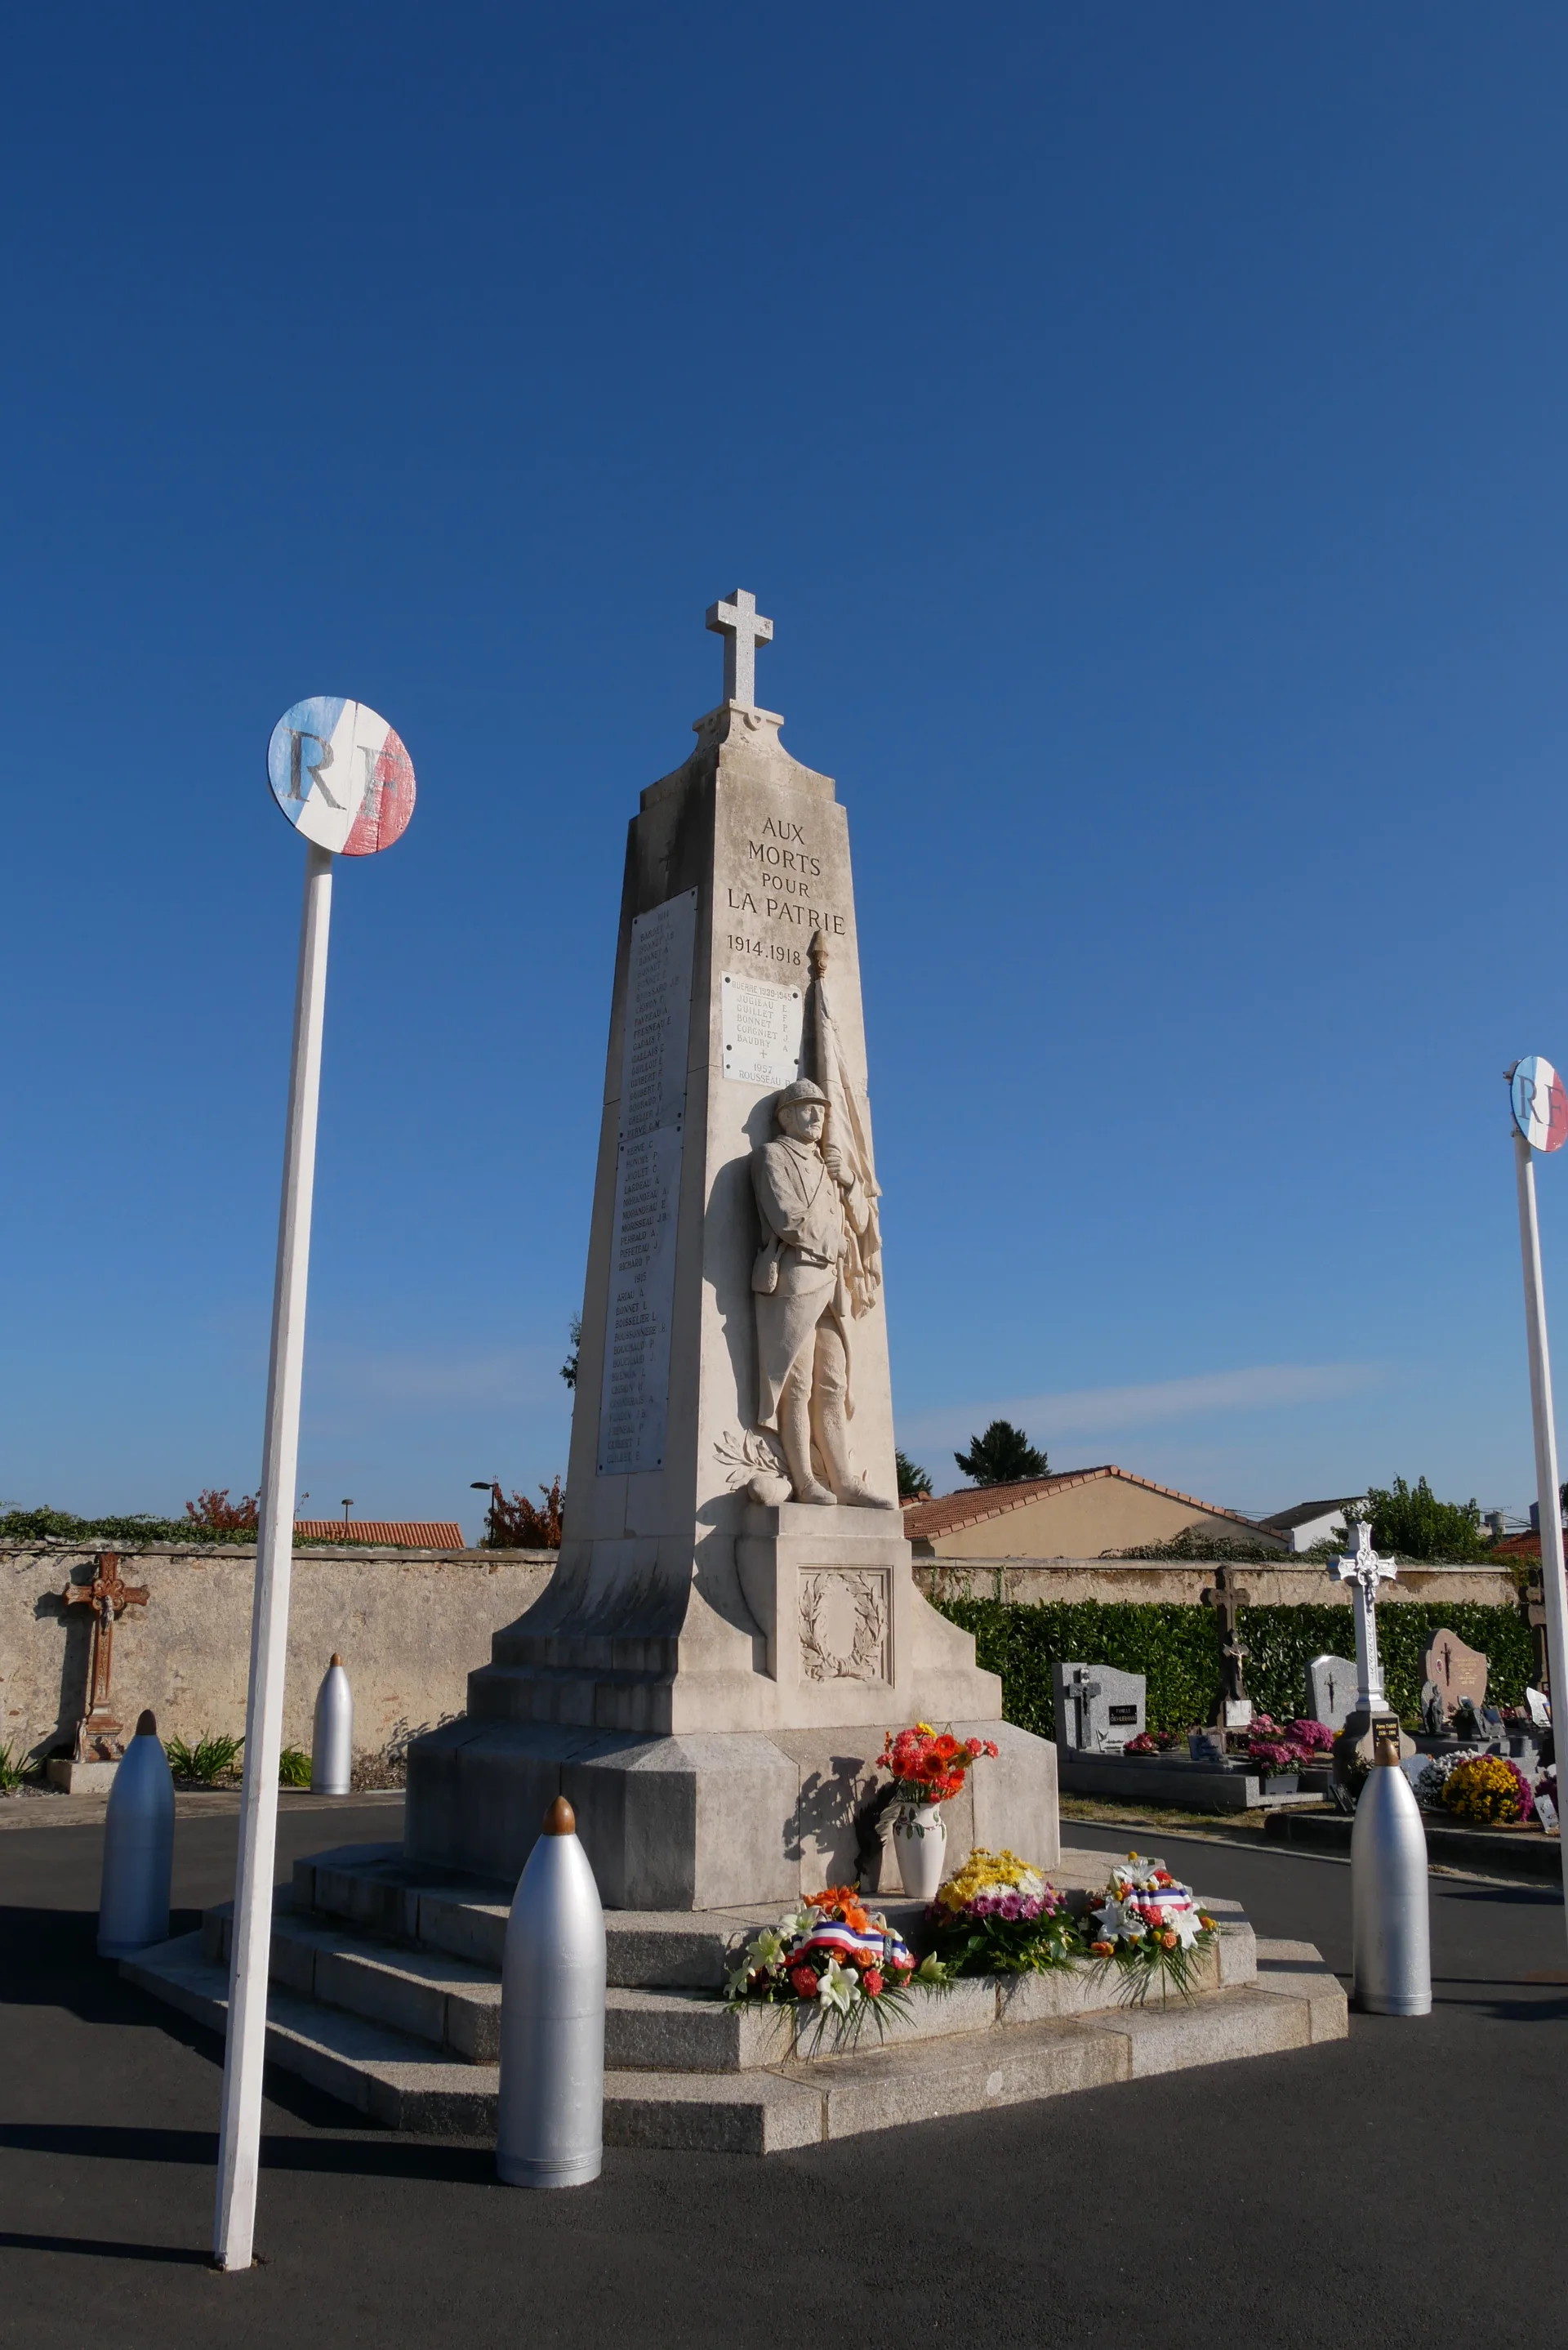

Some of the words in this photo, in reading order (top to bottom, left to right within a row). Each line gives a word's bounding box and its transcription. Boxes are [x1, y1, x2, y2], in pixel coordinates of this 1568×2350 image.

[283, 725, 406, 820] RF
[762, 817, 805, 845] AUX
[749, 840, 821, 876] MORTS
[762, 872, 810, 899] POUR
[728, 888, 757, 914] LA
[766, 898, 846, 936] PATRIE
[639, 949, 662, 966] BONNET
[638, 961, 661, 979] BONNET
[732, 981, 759, 994] GUERRE
[759, 987, 792, 1002] 1939-1945
[737, 995, 774, 1010] JUGIEAU
[737, 1005, 774, 1019] GUILLET
[634, 1019, 665, 1040] FRESNEAU
[737, 1014, 772, 1028] BONNET
[737, 1024, 778, 1040] CORGNIET
[737, 1033, 771, 1048] BAUDRY
[632, 1046, 658, 1064] GALLAIS
[754, 1064, 773, 1074] 1957
[630, 1072, 657, 1089] GUIBERT
[739, 1070, 782, 1086] ROUSSEAU
[630, 1084, 656, 1101] GUIBERT
[1517, 1074, 1564, 1126] RF
[623, 1189, 658, 1208] MORANDEAU
[622, 1202, 658, 1221] MORANDEAU
[621, 1215, 655, 1234] MORISSEAU
[619, 1242, 650, 1259] PIFFETEAU
[618, 1255, 643, 1272] RICHARD
[617, 1290, 635, 1303] ARIAU
[615, 1302, 639, 1316] BONNET
[614, 1313, 650, 1329] BOISSELIER
[613, 1340, 645, 1355] BOUCHAUD
